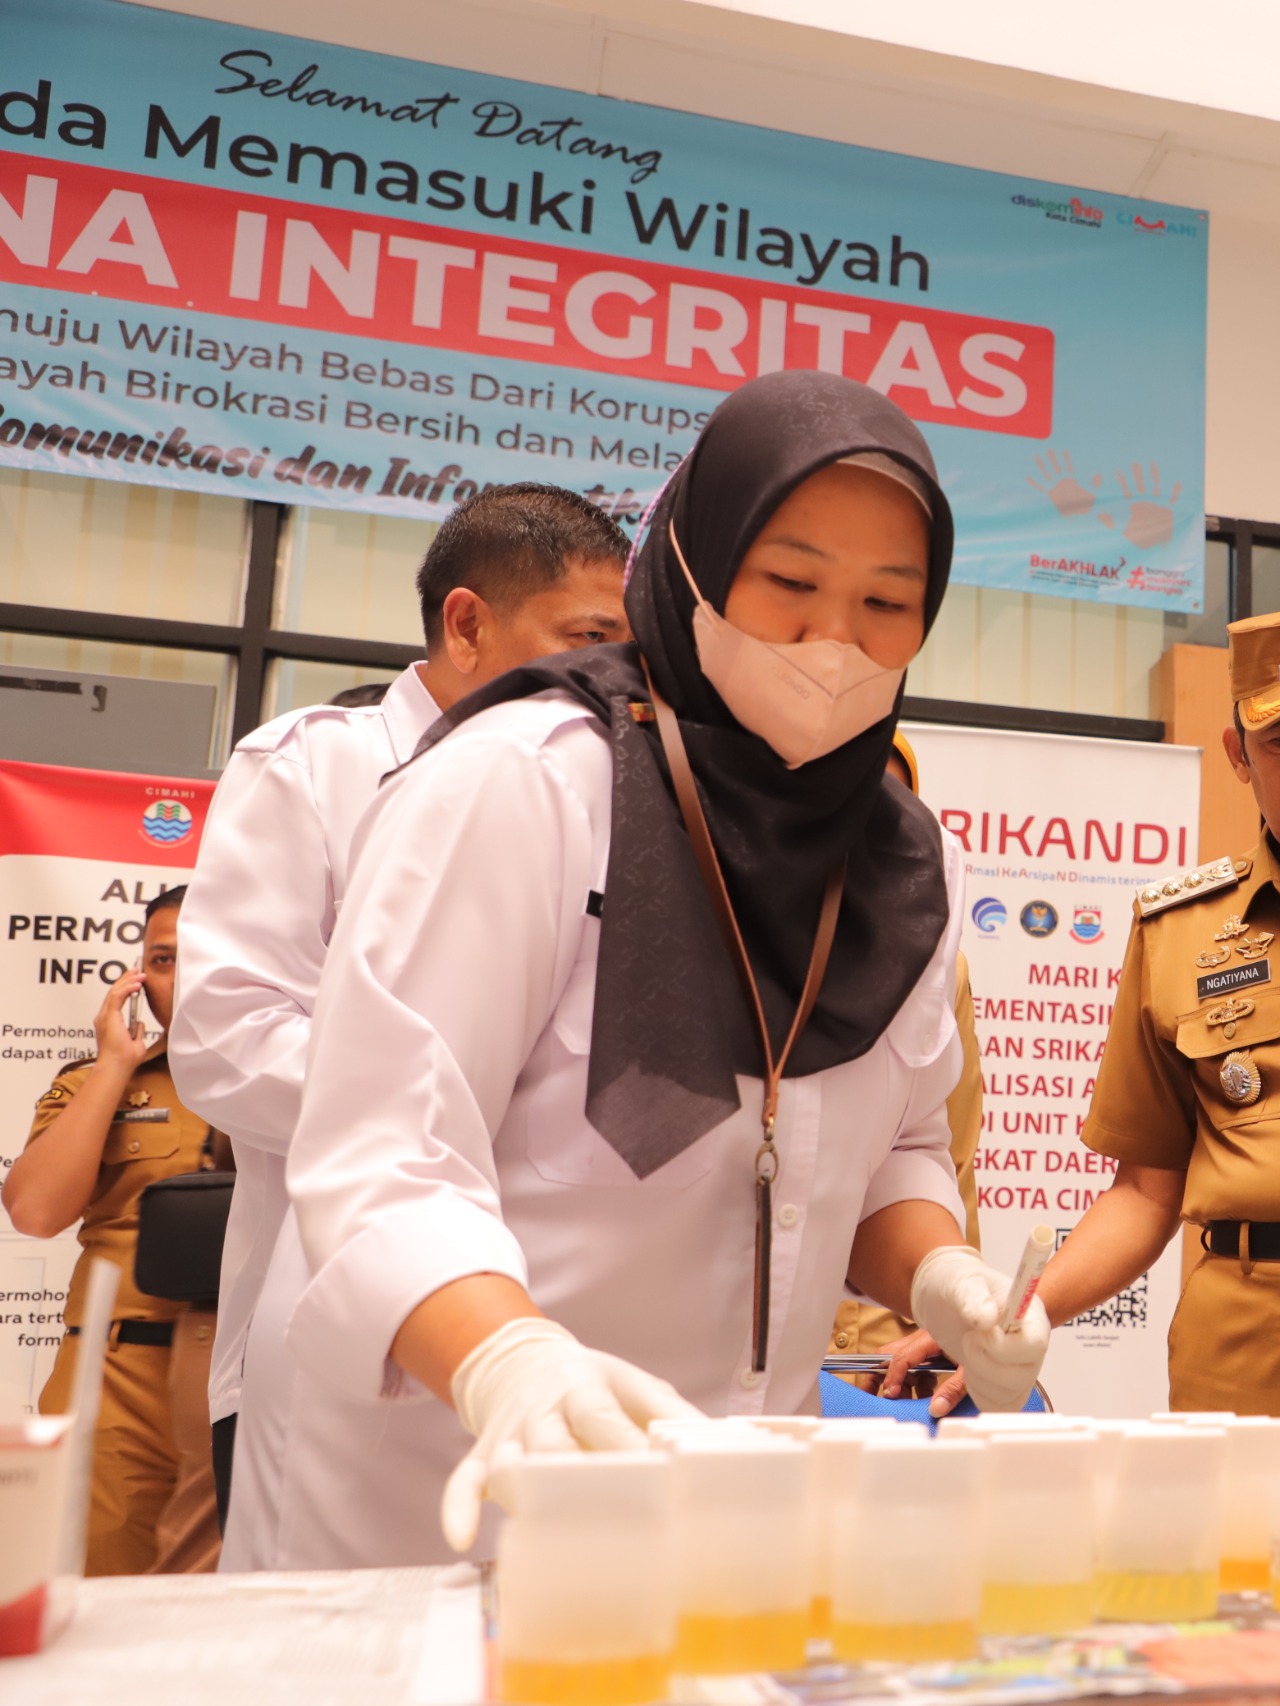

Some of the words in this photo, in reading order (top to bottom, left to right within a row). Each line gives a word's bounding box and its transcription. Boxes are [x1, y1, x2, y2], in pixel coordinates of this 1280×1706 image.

[215, 49, 461, 129] Selamat
[472, 101, 663, 185] Datang
[0, 79, 106, 150] da
[144, 103, 597, 235] Memasuki
[624, 190, 931, 292] Wilayah
[228, 209, 1029, 418] INTEGRITAS
[118, 319, 304, 375] Wilayah
[320, 350, 456, 397] Bebas
[469, 373, 555, 411] Dari
[125, 368, 329, 425] Birokrasi
[344, 400, 481, 447] Bersih
[496, 423, 575, 459] dan
[0, 403, 271, 480] omunikasi
[273, 445, 373, 494] dan
[1030, 554, 1123, 581] BerAKHLAK
[145, 787, 196, 799] CIMAHI
[940, 808, 1187, 867] RIKANDI
[1029, 964, 1098, 989] MARI
[1206, 967, 1260, 990] NGATIYANA
[1, 1047, 53, 1062] dapat
[979, 1036, 1023, 1058] AN
[1003, 1111, 1068, 1135] UNIT
[977, 1186, 1048, 1210] KOTA
